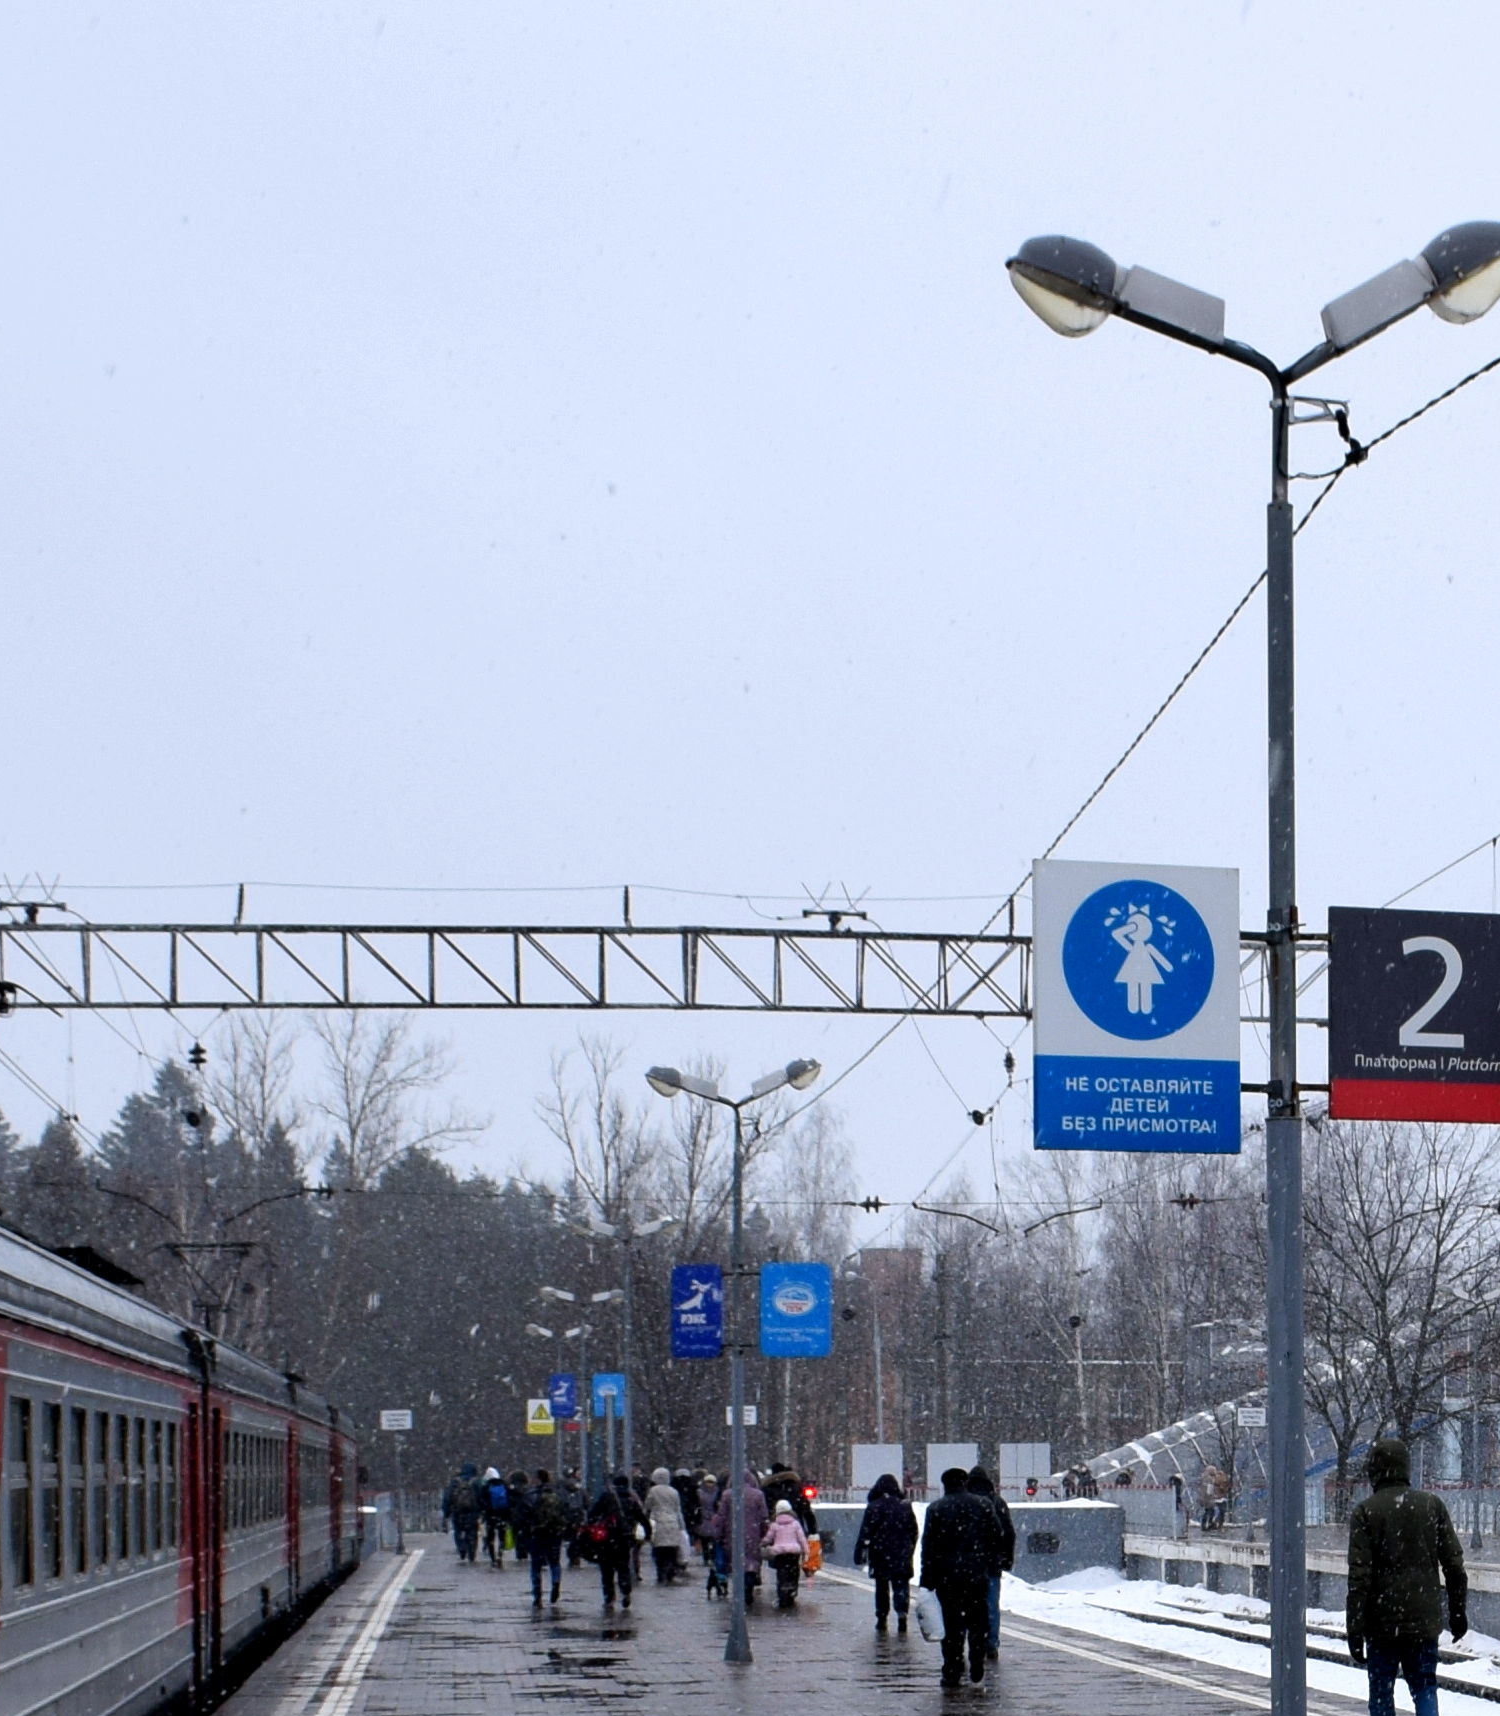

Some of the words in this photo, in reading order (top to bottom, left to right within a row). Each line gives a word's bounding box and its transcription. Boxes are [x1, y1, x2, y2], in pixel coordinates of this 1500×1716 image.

[1398, 935, 1465, 1049] 2
[1354, 1053, 1437, 1073] Платформа
[1065, 1077, 1089, 1092] НЕ
[1095, 1076, 1214, 1095] ОСТАВЛЯЙТЕ
[1110, 1096, 1169, 1114] ДЕТЕЙ
[1061, 1116, 1097, 1131] БЕЗ
[1102, 1117, 1217, 1134] ПРИСМОТРА!
